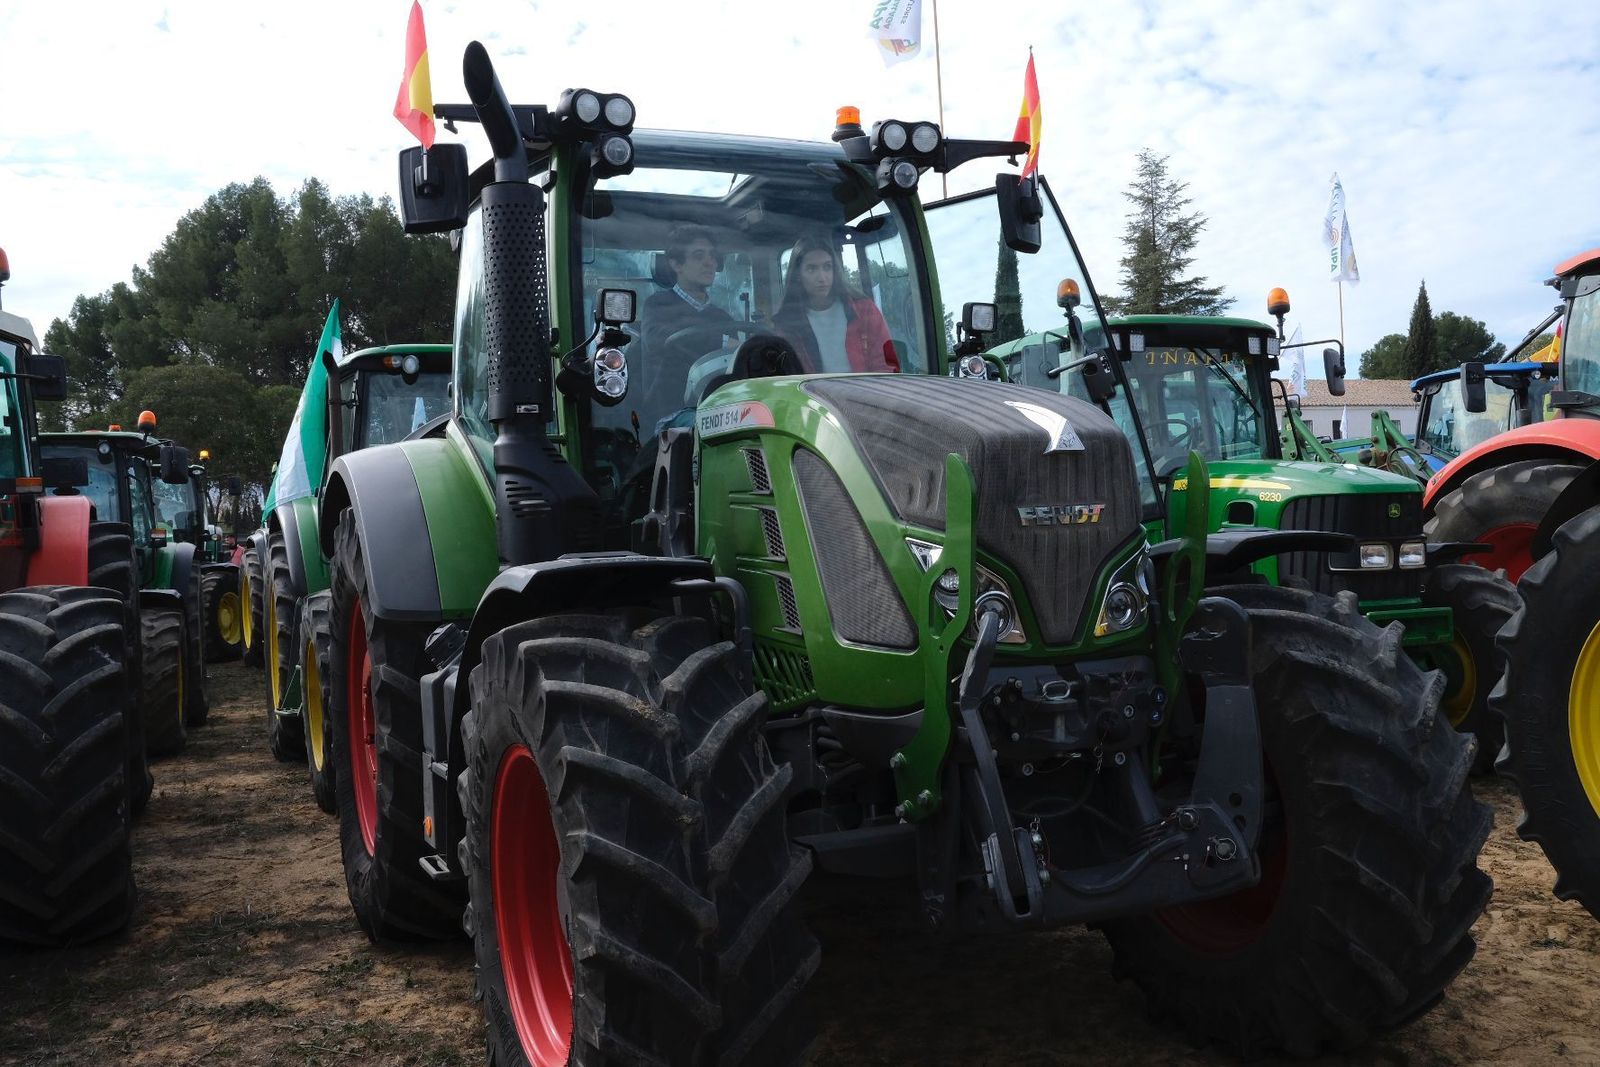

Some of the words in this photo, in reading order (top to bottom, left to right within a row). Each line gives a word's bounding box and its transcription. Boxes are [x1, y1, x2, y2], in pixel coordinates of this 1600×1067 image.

[1331, 246, 1339, 273] UPA
[701, 413, 724, 431] FENDT
[725, 408, 739, 425] 514
[1259, 491, 1281, 503] 6230
[1017, 503, 1106, 527] FENDT
